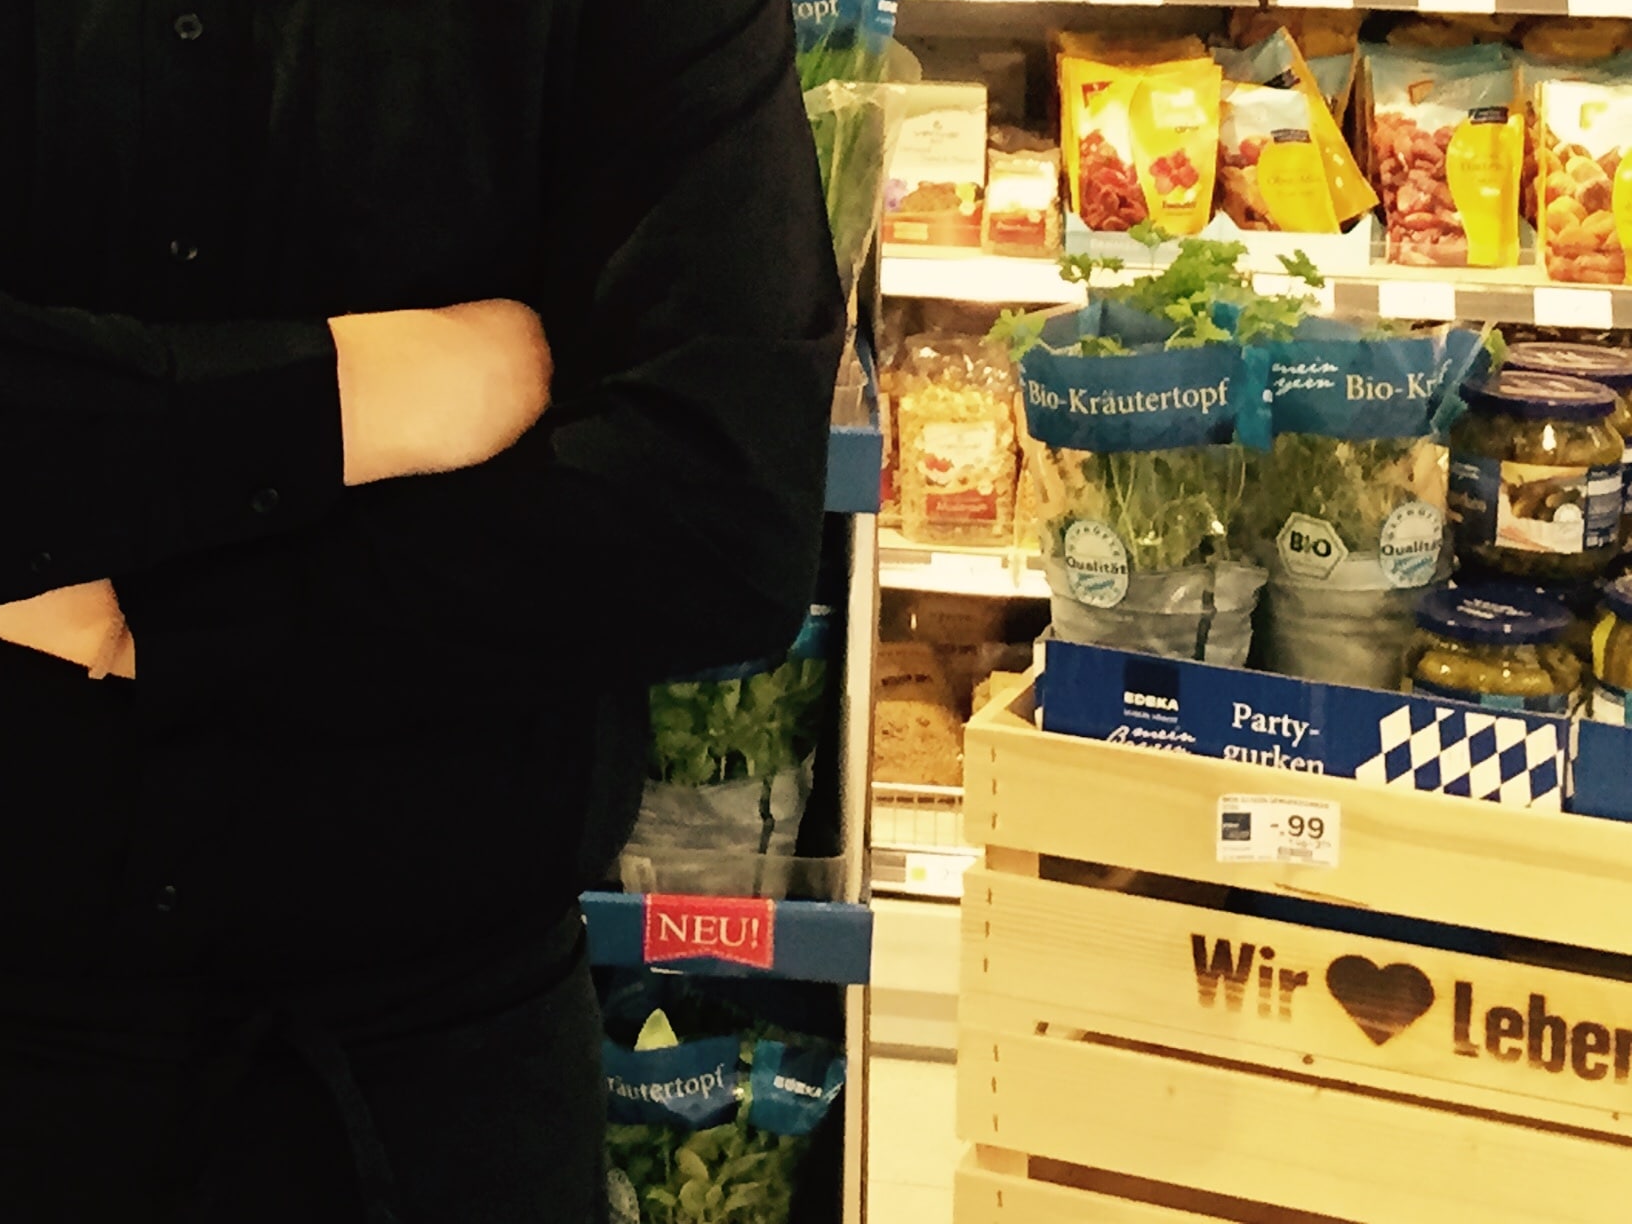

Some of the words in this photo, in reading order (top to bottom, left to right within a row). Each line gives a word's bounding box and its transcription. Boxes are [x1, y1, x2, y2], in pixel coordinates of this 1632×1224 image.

[1027, 377, 1231, 416] Bio-Kräutertopf
[1289, 530, 1332, 558] BIO
[1065, 555, 1129, 576] Qualität
[1123, 690, 1180, 713] EDEKA
[1231, 701, 1320, 748] Party-
[657, 912, 760, 950] NEU!
[1190, 932, 1309, 1023] Wir
